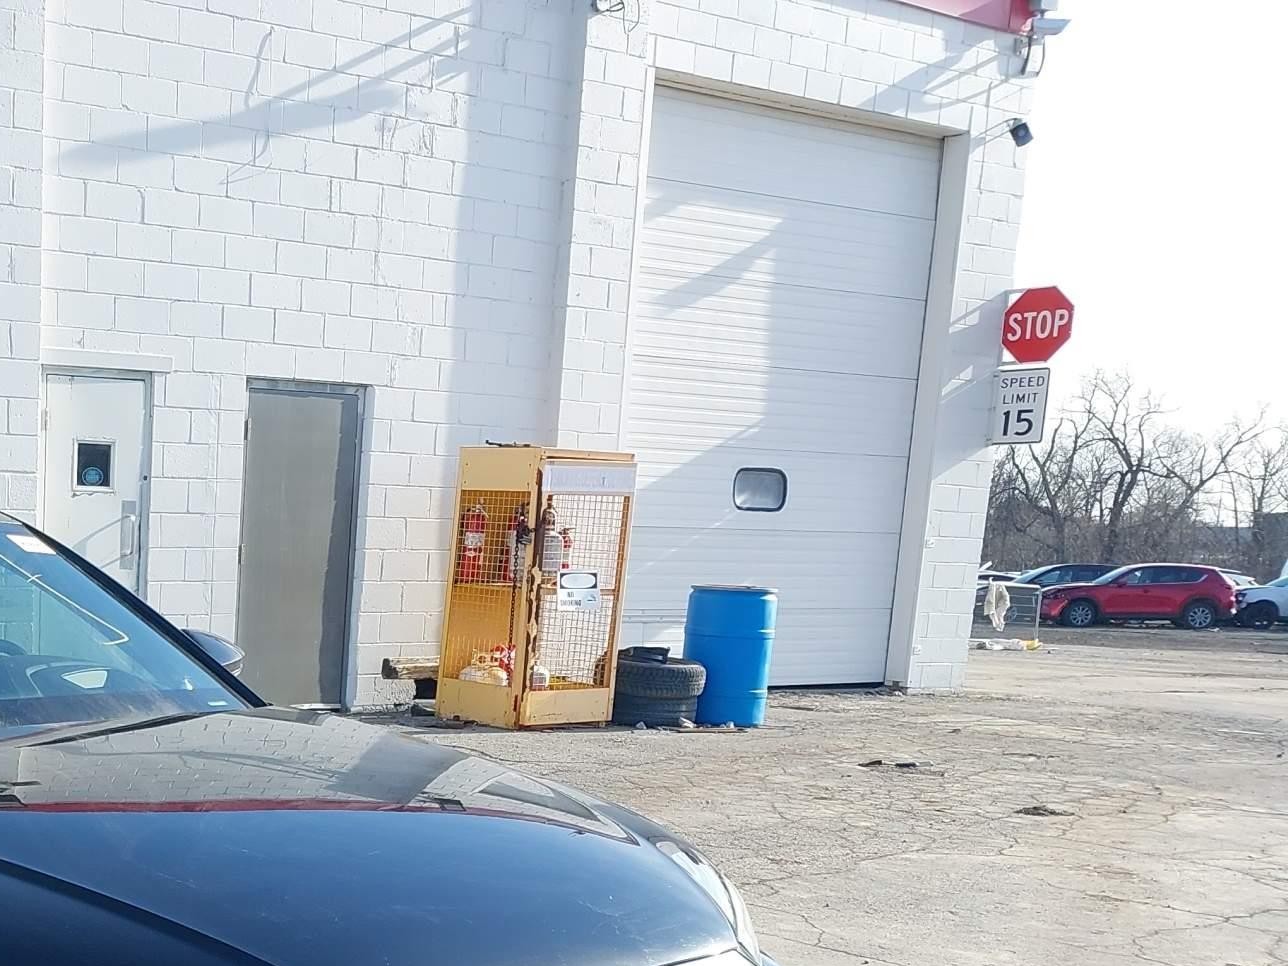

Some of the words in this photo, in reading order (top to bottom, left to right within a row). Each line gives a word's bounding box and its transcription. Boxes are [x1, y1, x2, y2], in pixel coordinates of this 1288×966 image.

[1007, 309, 1069, 341] STOP
[1000, 376, 1045, 389] SPEED
[1002, 393, 1039, 405] LIMIT
[1002, 409, 1034, 436] 15
